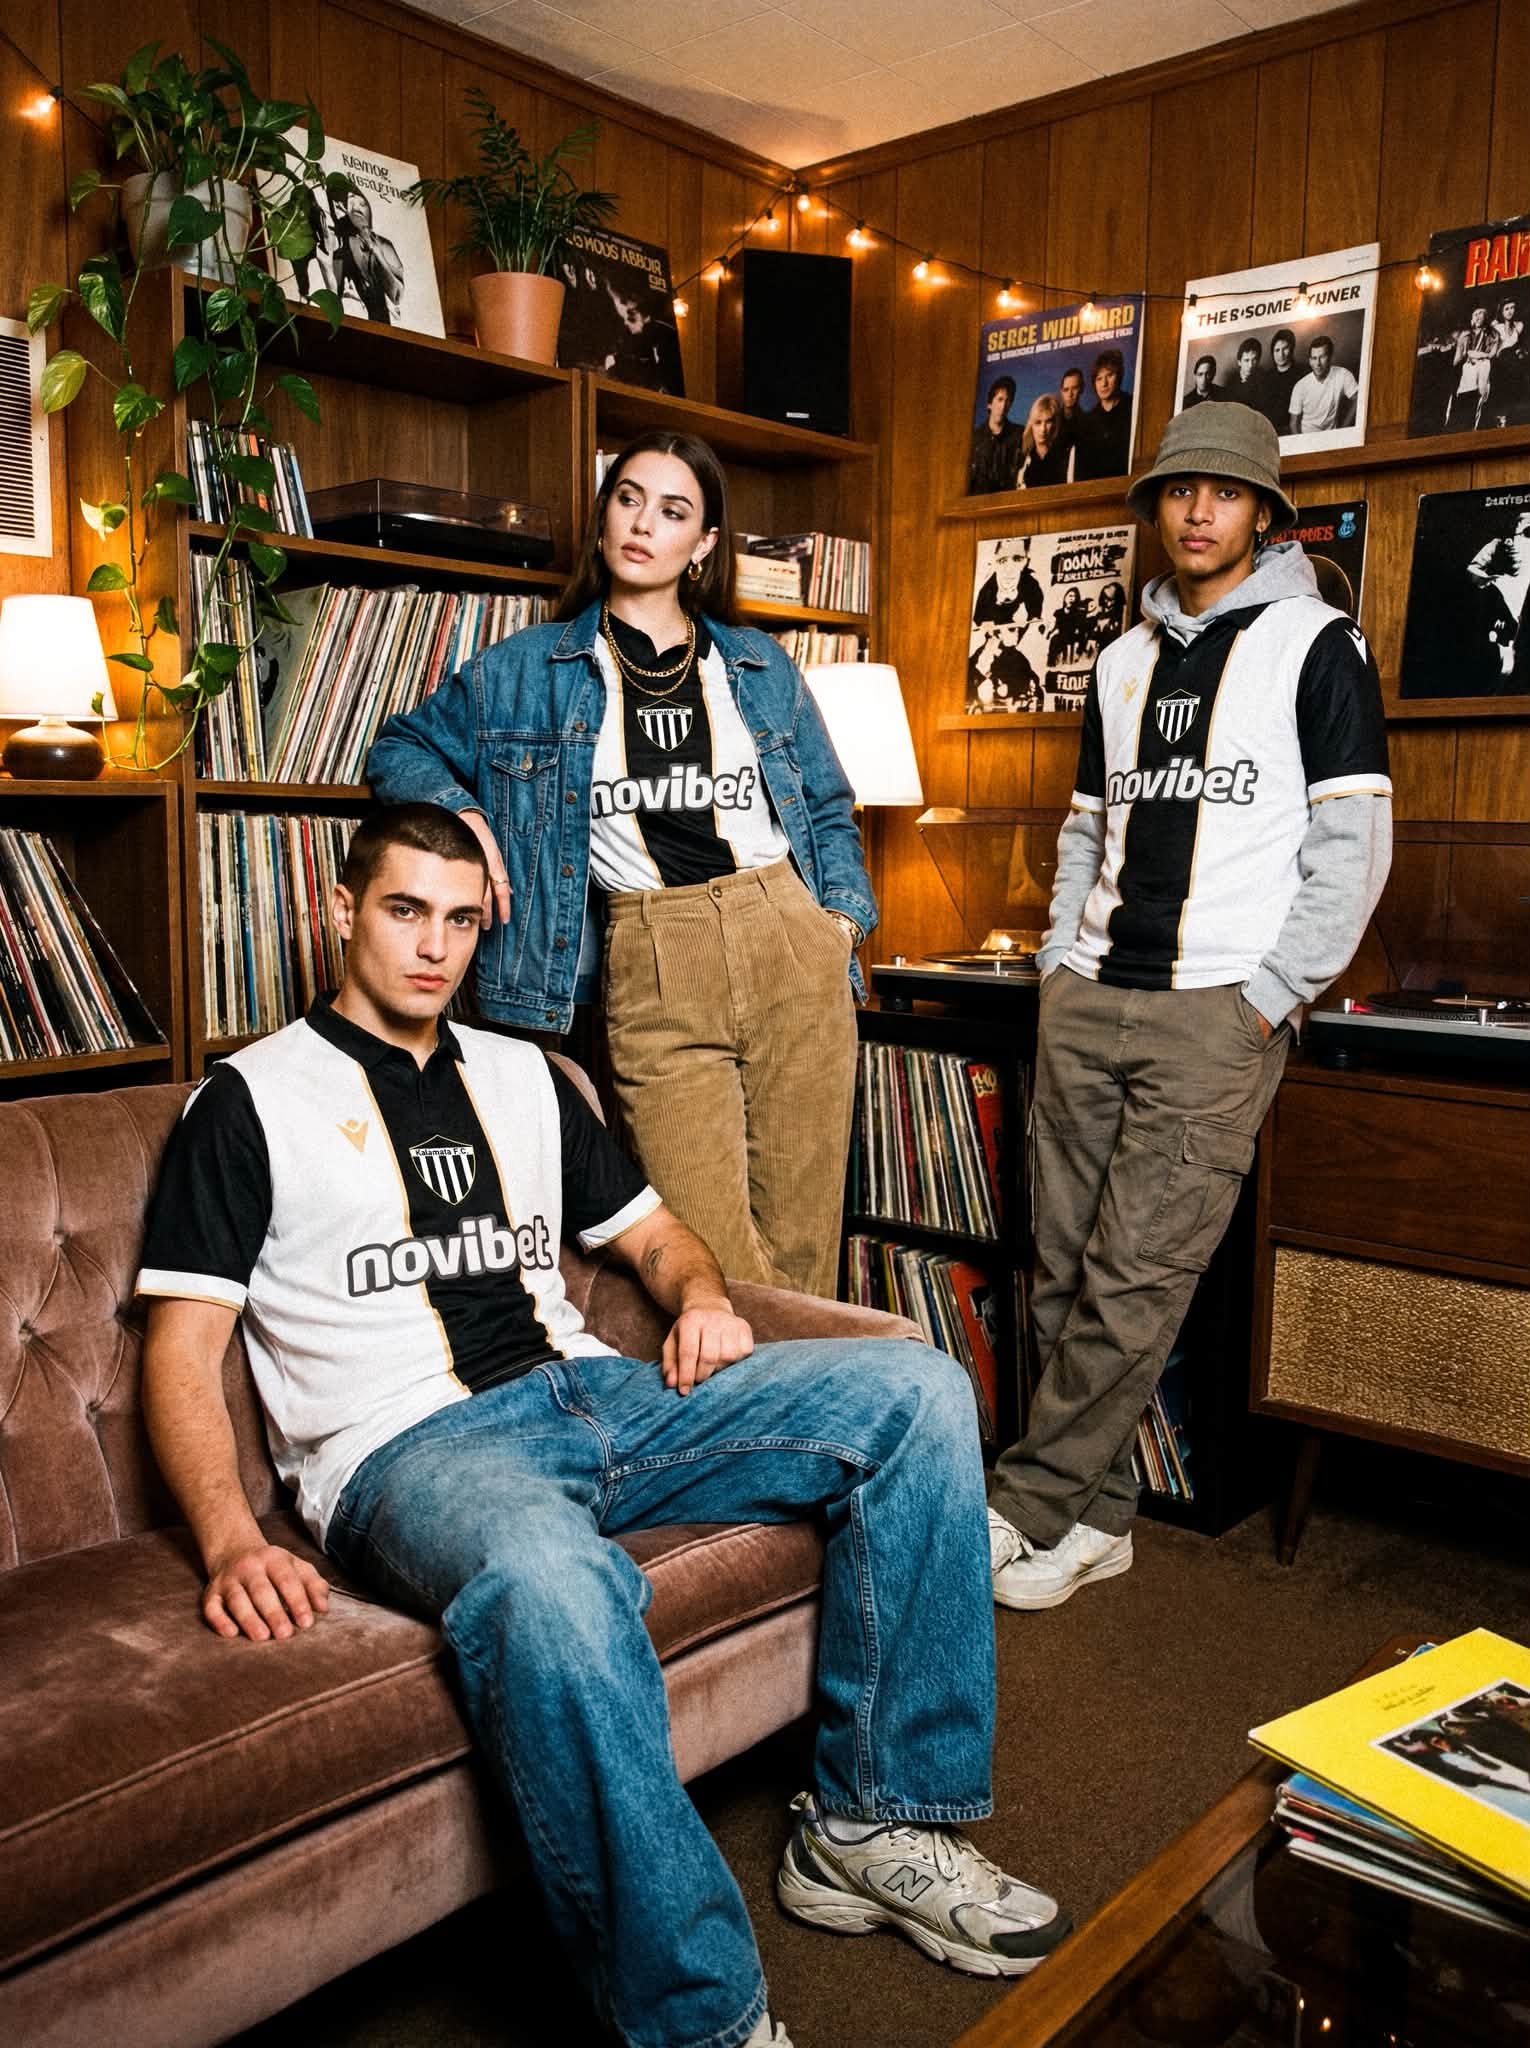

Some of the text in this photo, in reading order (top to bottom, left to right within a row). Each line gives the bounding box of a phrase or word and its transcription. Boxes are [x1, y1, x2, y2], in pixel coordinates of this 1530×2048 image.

[591, 763, 755, 819] novibet
[1107, 754, 1259, 807] novibet
[415, 1148, 452, 1156] Kalamata
[347, 1214, 554, 1297] novibet
